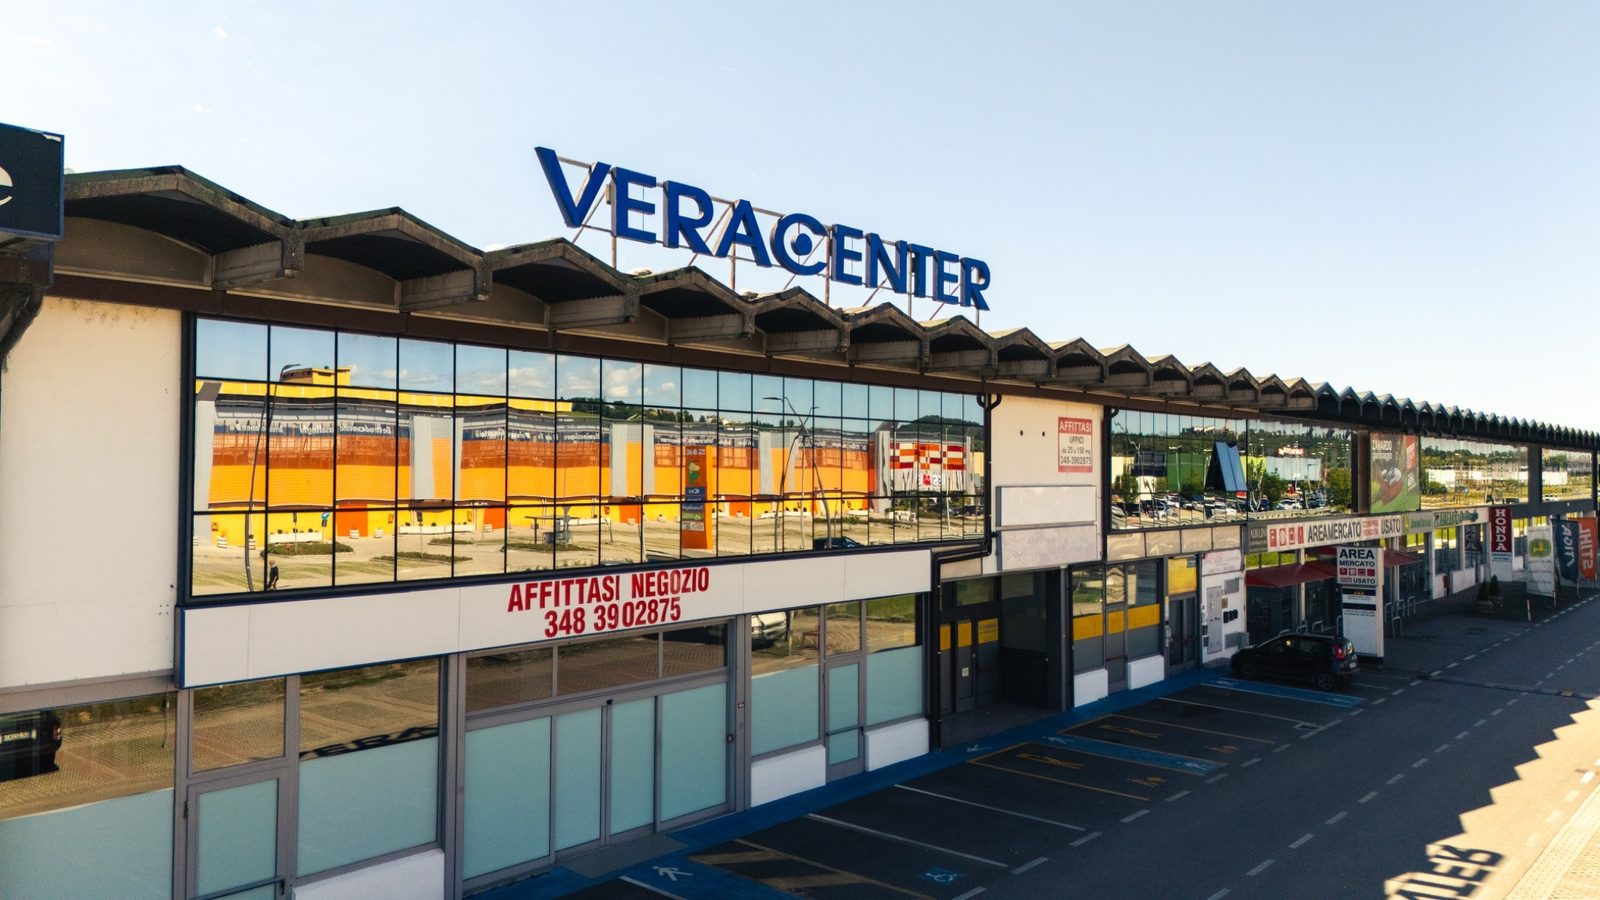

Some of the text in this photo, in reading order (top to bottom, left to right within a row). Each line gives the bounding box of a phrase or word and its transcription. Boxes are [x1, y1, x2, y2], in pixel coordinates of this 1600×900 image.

[534, 146, 991, 311] VERACENTER
[1060, 420, 1092, 432] AFFITTASI
[1380, 518, 1402, 535] USATO
[1495, 508, 1508, 552] HONDA
[1339, 549, 1375, 560] AREA
[1339, 560, 1376, 568] MERCATO
[507, 567, 710, 612] AFFITTASI NEGOZIO
[544, 606, 586, 638] 348
